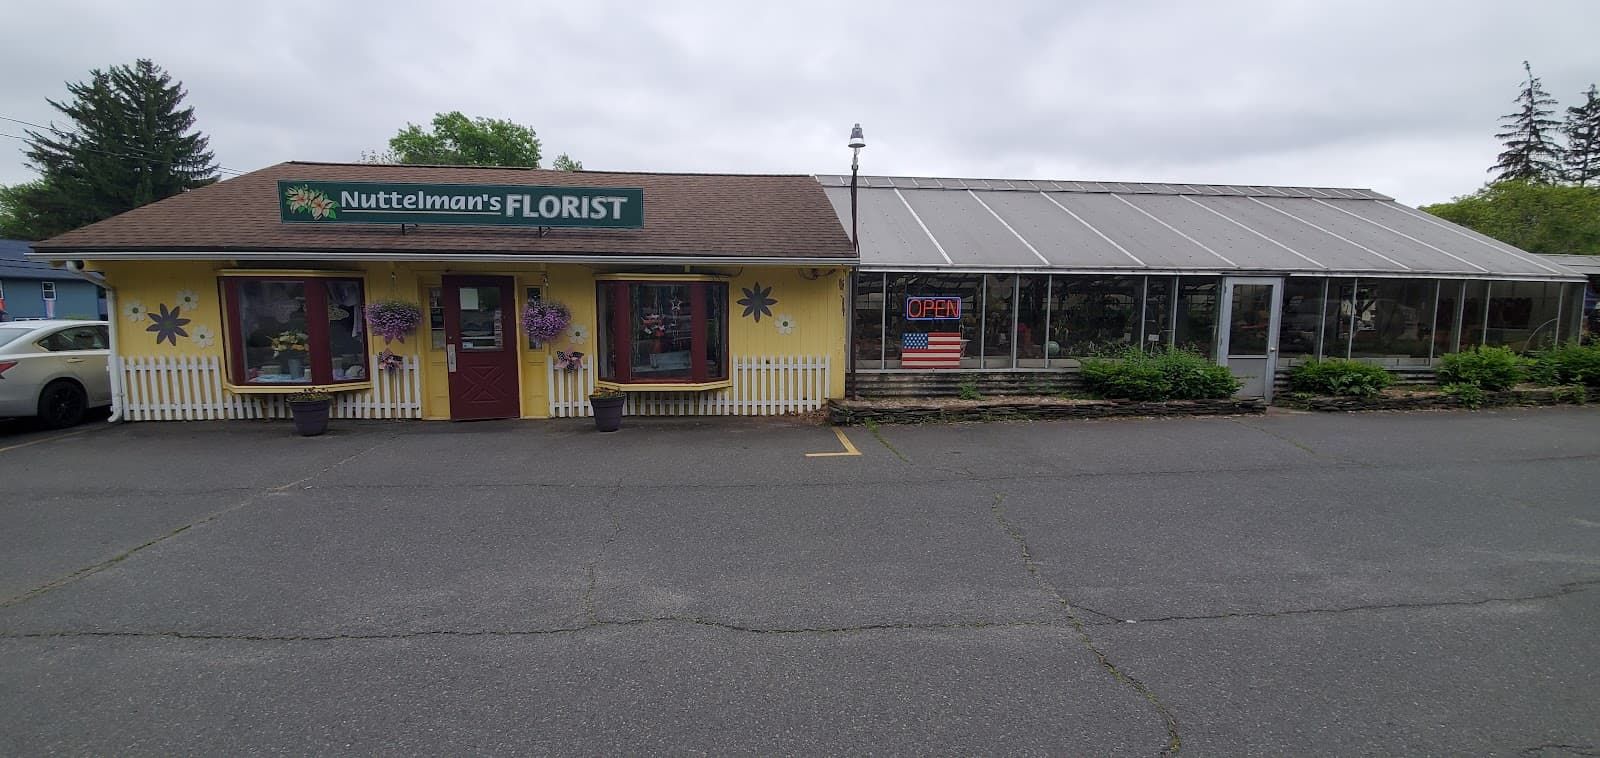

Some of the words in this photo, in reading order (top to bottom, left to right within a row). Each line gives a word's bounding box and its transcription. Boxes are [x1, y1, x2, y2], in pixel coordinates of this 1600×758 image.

[341, 190, 501, 211] Nuttelman's
[506, 194, 628, 220] FLORIST
[909, 299, 960, 318] OPEN
